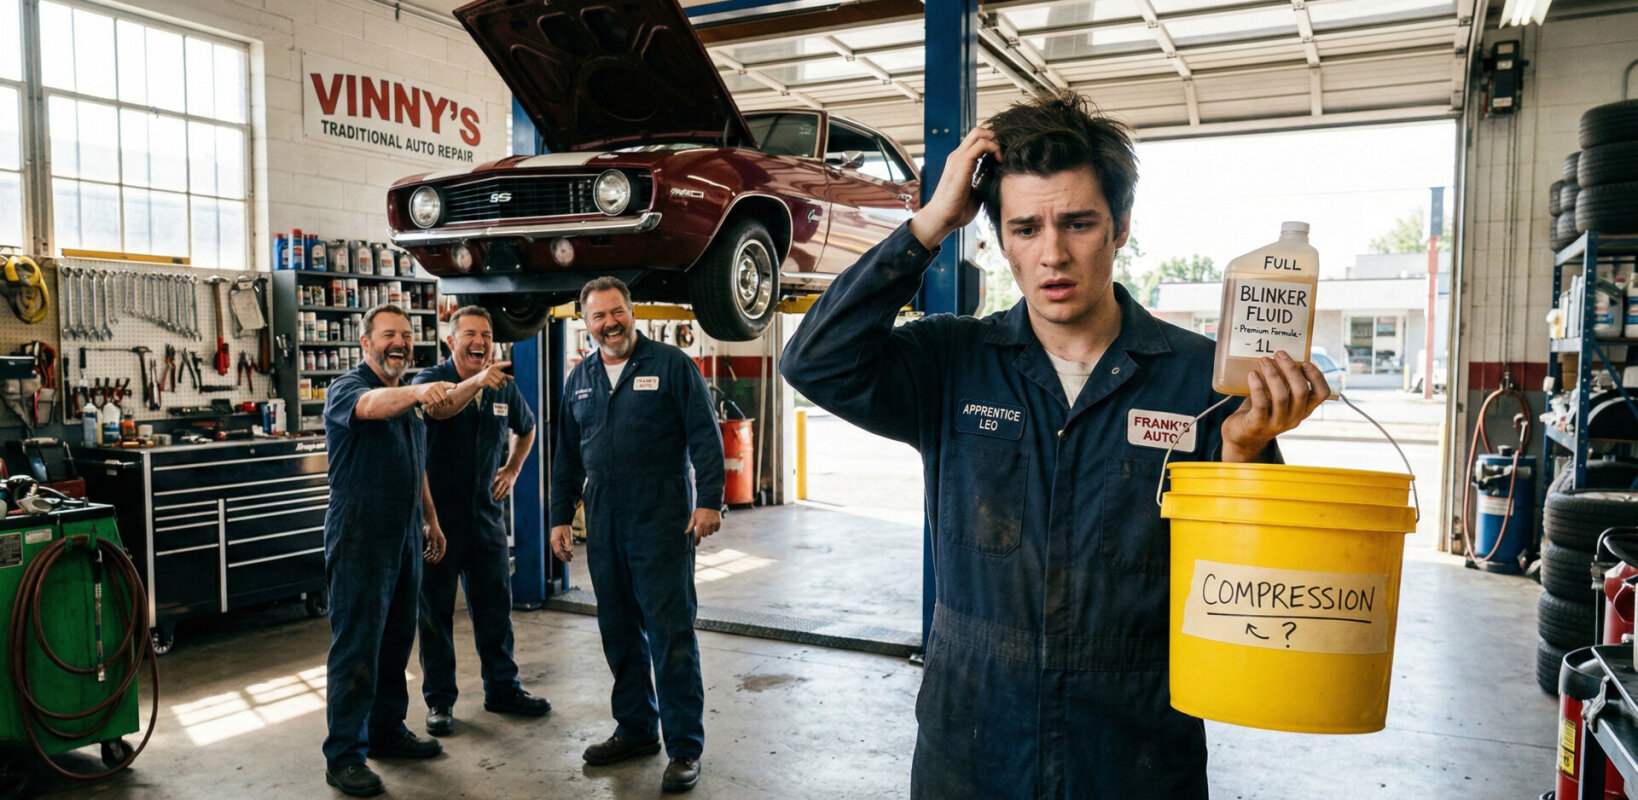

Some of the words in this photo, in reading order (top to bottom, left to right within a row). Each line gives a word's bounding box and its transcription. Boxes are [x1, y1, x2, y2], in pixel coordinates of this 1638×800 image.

[310, 73, 481, 147] VINNY'S
[321, 120, 402, 149] TRADITIONAL
[406, 138, 435, 156] AUTO
[438, 144, 474, 163] REPAIR
[489, 192, 512, 203] SS
[1264, 255, 1302, 271] FULL
[1240, 285, 1307, 307] BLINKER
[1246, 306, 1293, 324] FLUID
[1239, 324, 1269, 335] Premium
[963, 404, 1021, 422] APPRENTICE
[979, 418, 998, 431] LEO
[1134, 416, 1190, 433] FRANK'S
[1143, 430, 1179, 444] AUTO
[1202, 573, 1375, 612] COMPRESSION
[1282, 621, 1297, 648] ?
